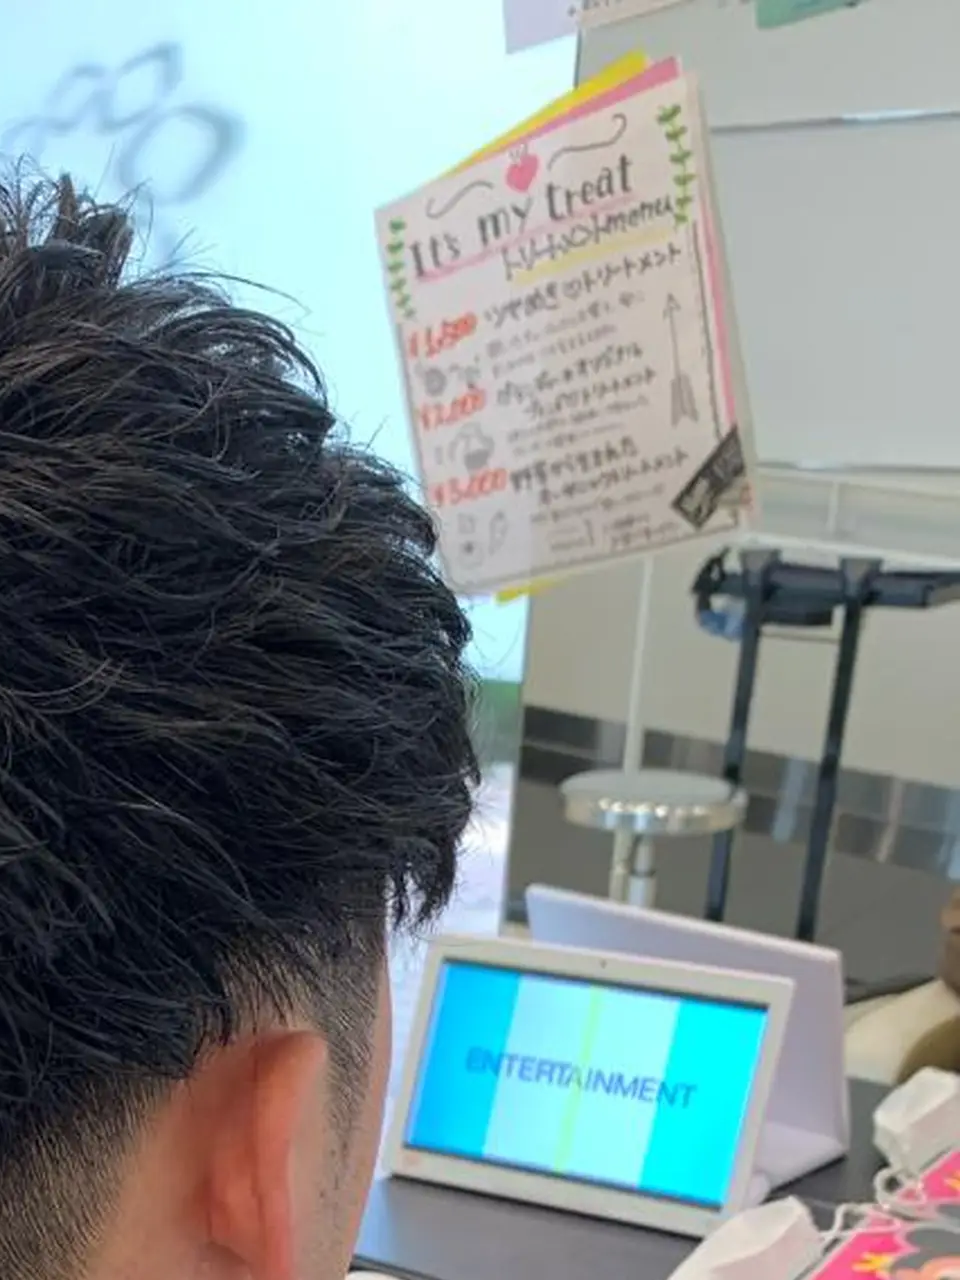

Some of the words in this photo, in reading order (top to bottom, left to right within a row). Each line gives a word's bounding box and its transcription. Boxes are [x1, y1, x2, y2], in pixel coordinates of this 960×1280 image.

[477, 196, 534, 247] my
[545, 153, 632, 221] treat
[465, 1045, 697, 1109] ENTERTAINMENT
